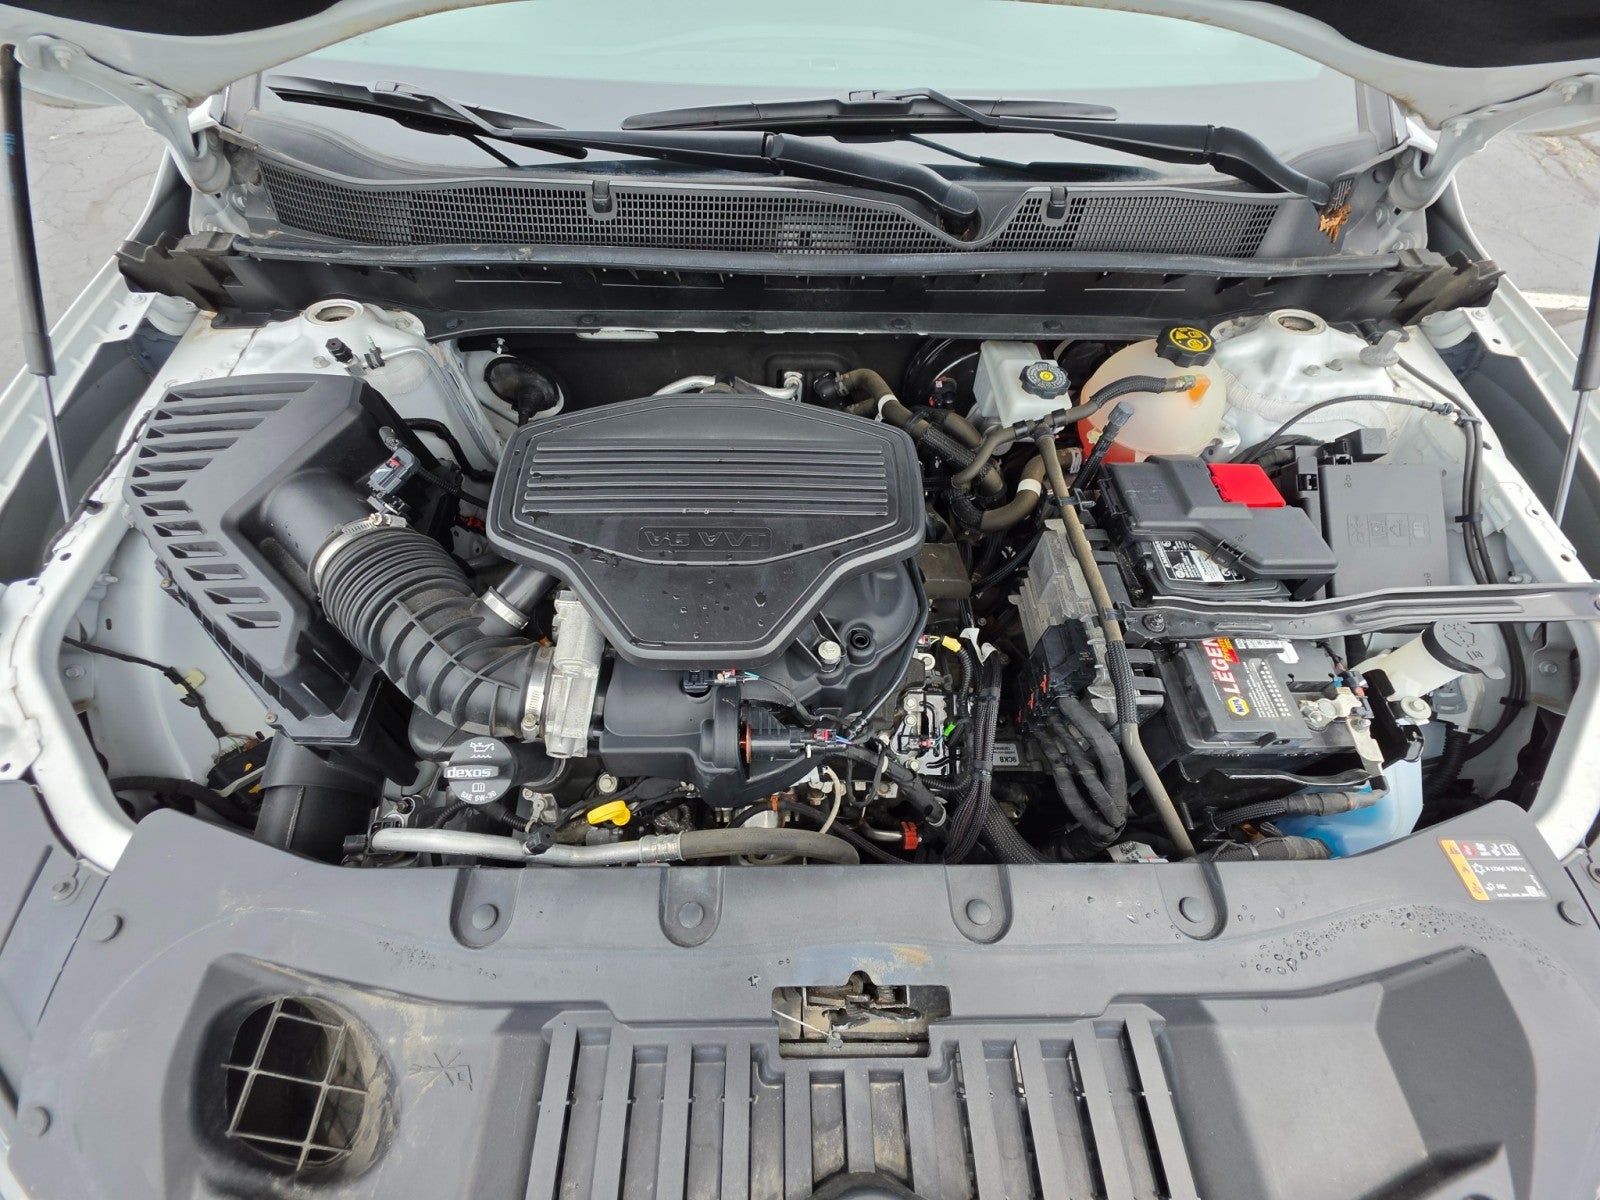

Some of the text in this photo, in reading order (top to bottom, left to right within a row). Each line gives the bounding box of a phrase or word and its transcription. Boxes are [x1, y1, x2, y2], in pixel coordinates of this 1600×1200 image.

[697, 530, 767, 547] VVT
[447, 767, 492, 778] dexos
[460, 791, 473, 801] SAE
